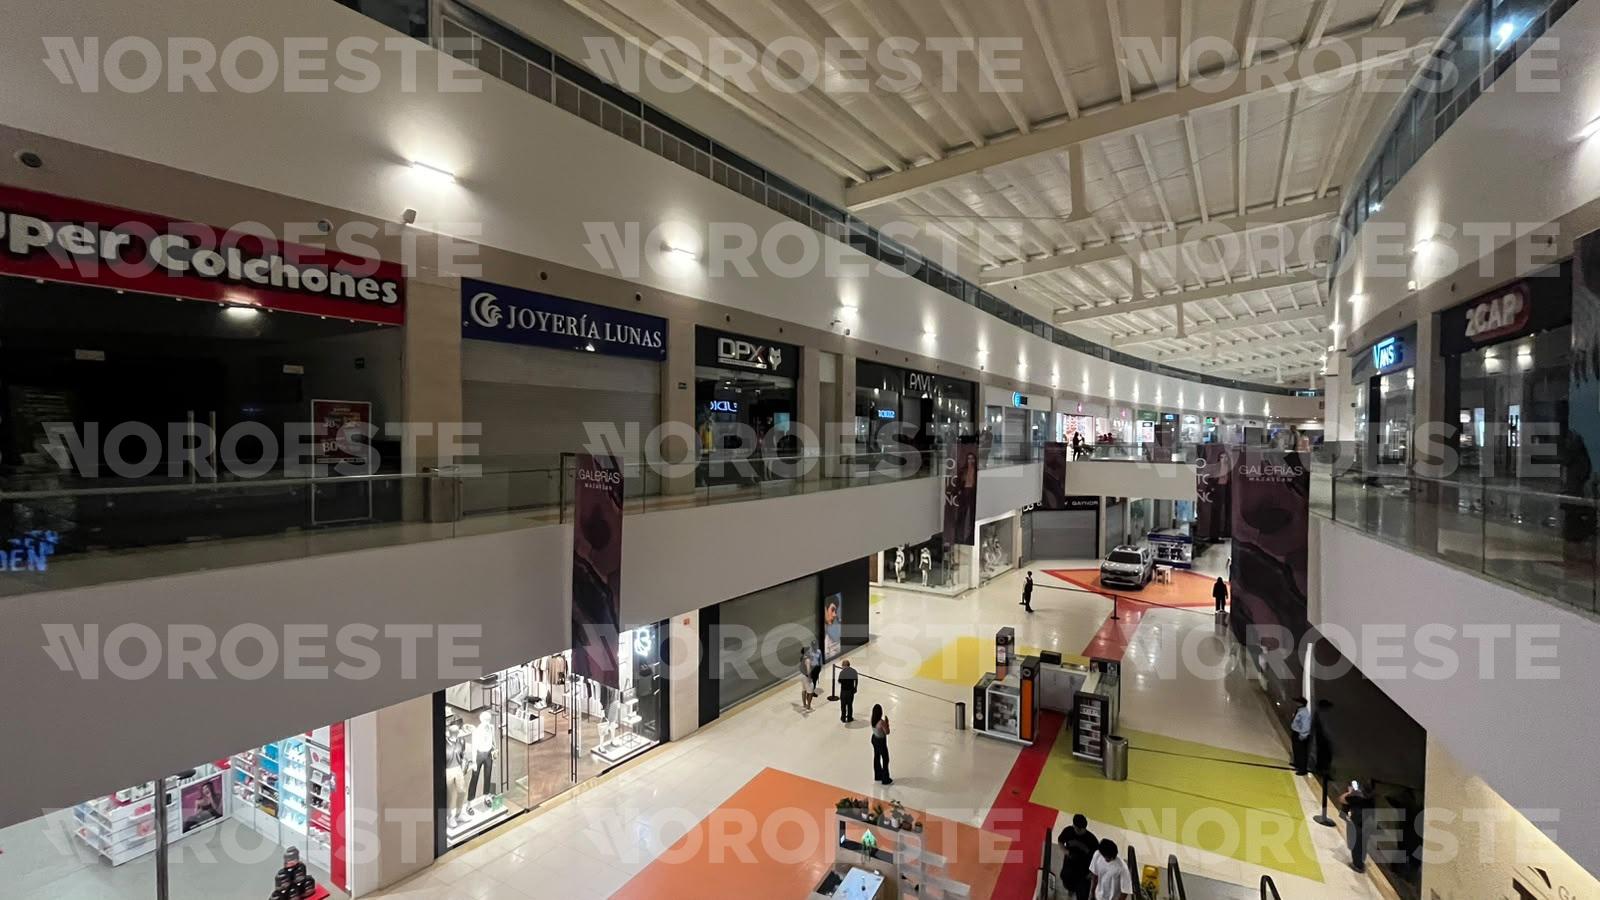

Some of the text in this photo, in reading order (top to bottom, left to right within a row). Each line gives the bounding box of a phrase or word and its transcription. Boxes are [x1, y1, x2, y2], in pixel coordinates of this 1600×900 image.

[149, 233, 398, 305] Colchones
[506, 304, 664, 350] JOYERÍA LUNAS
[718, 337, 764, 363] DPX
